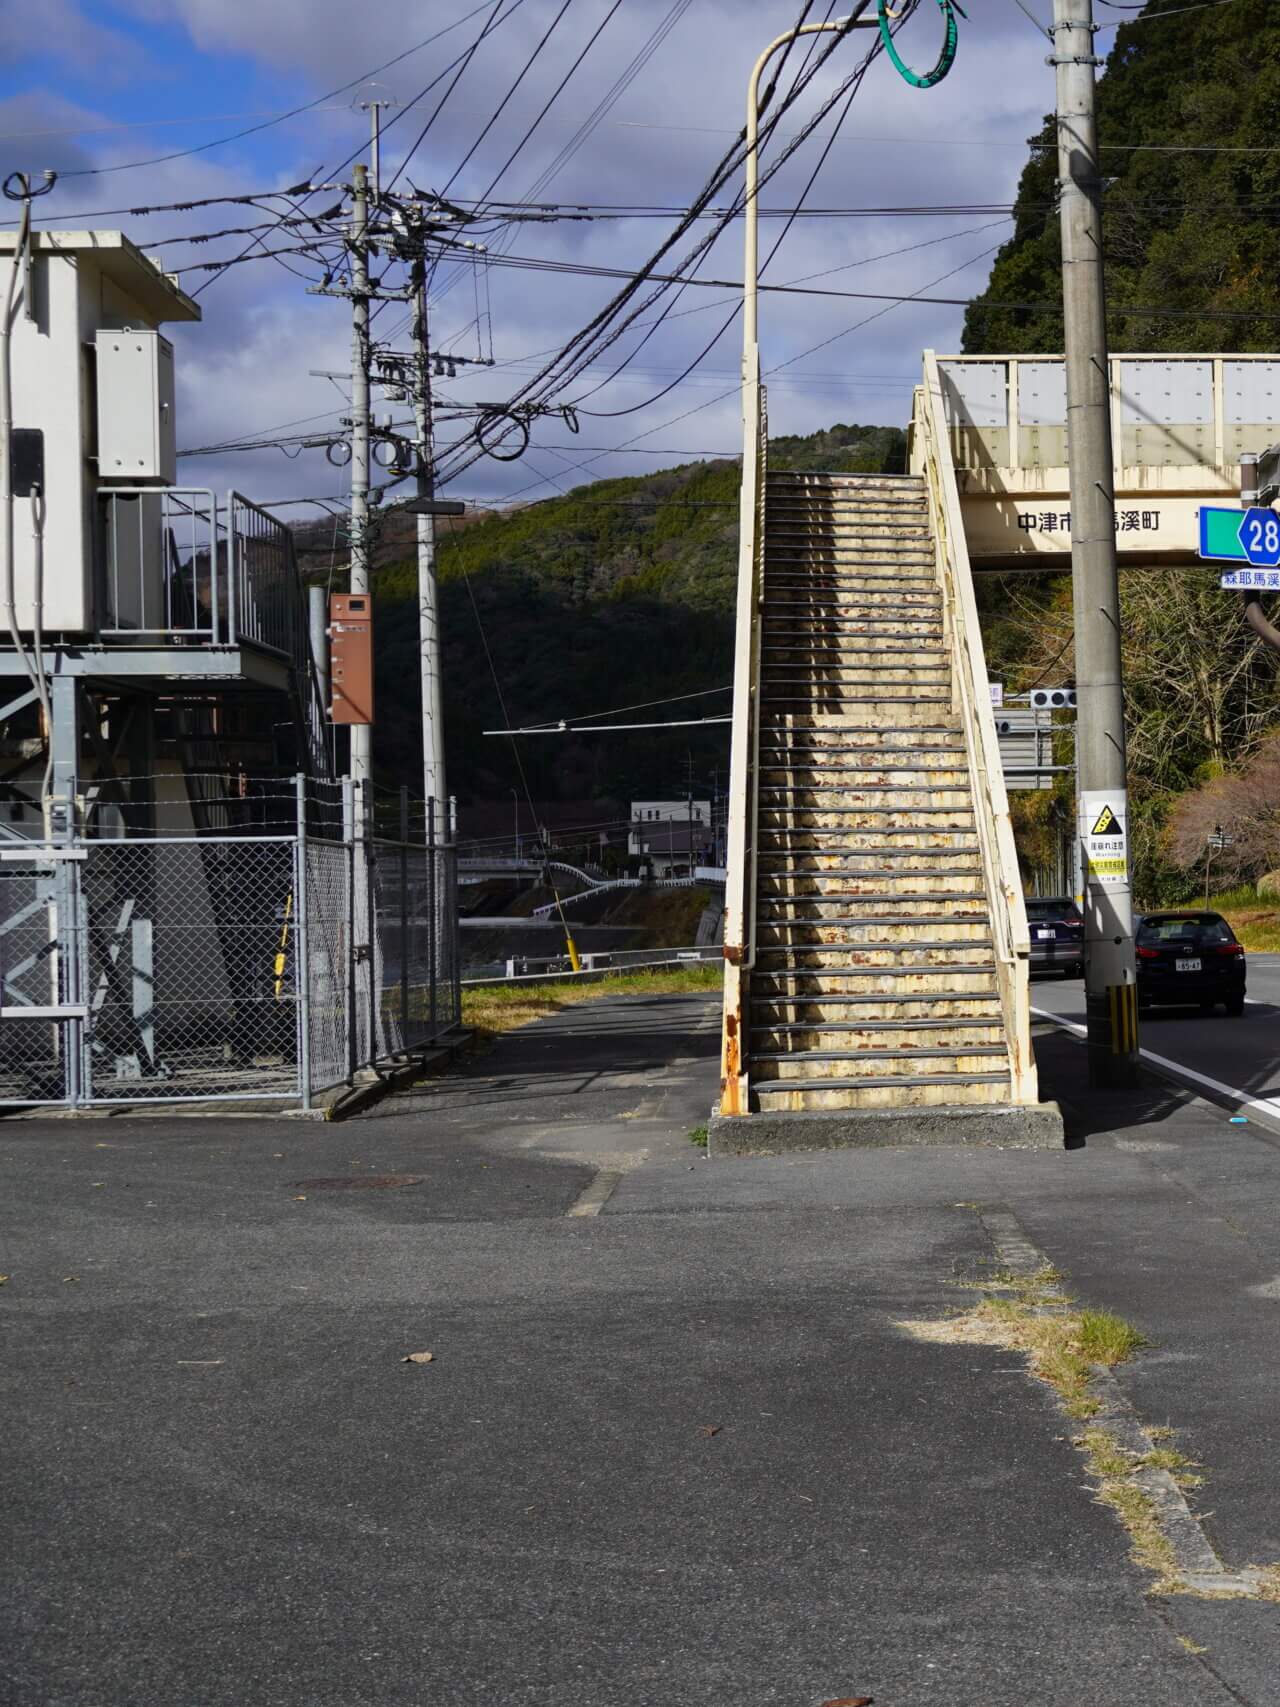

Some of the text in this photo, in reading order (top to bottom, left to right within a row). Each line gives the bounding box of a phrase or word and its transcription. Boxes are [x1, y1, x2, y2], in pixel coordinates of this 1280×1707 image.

[1017, 510, 1160, 533] 中津市溪町
[1249, 519, 1279, 553] 28
